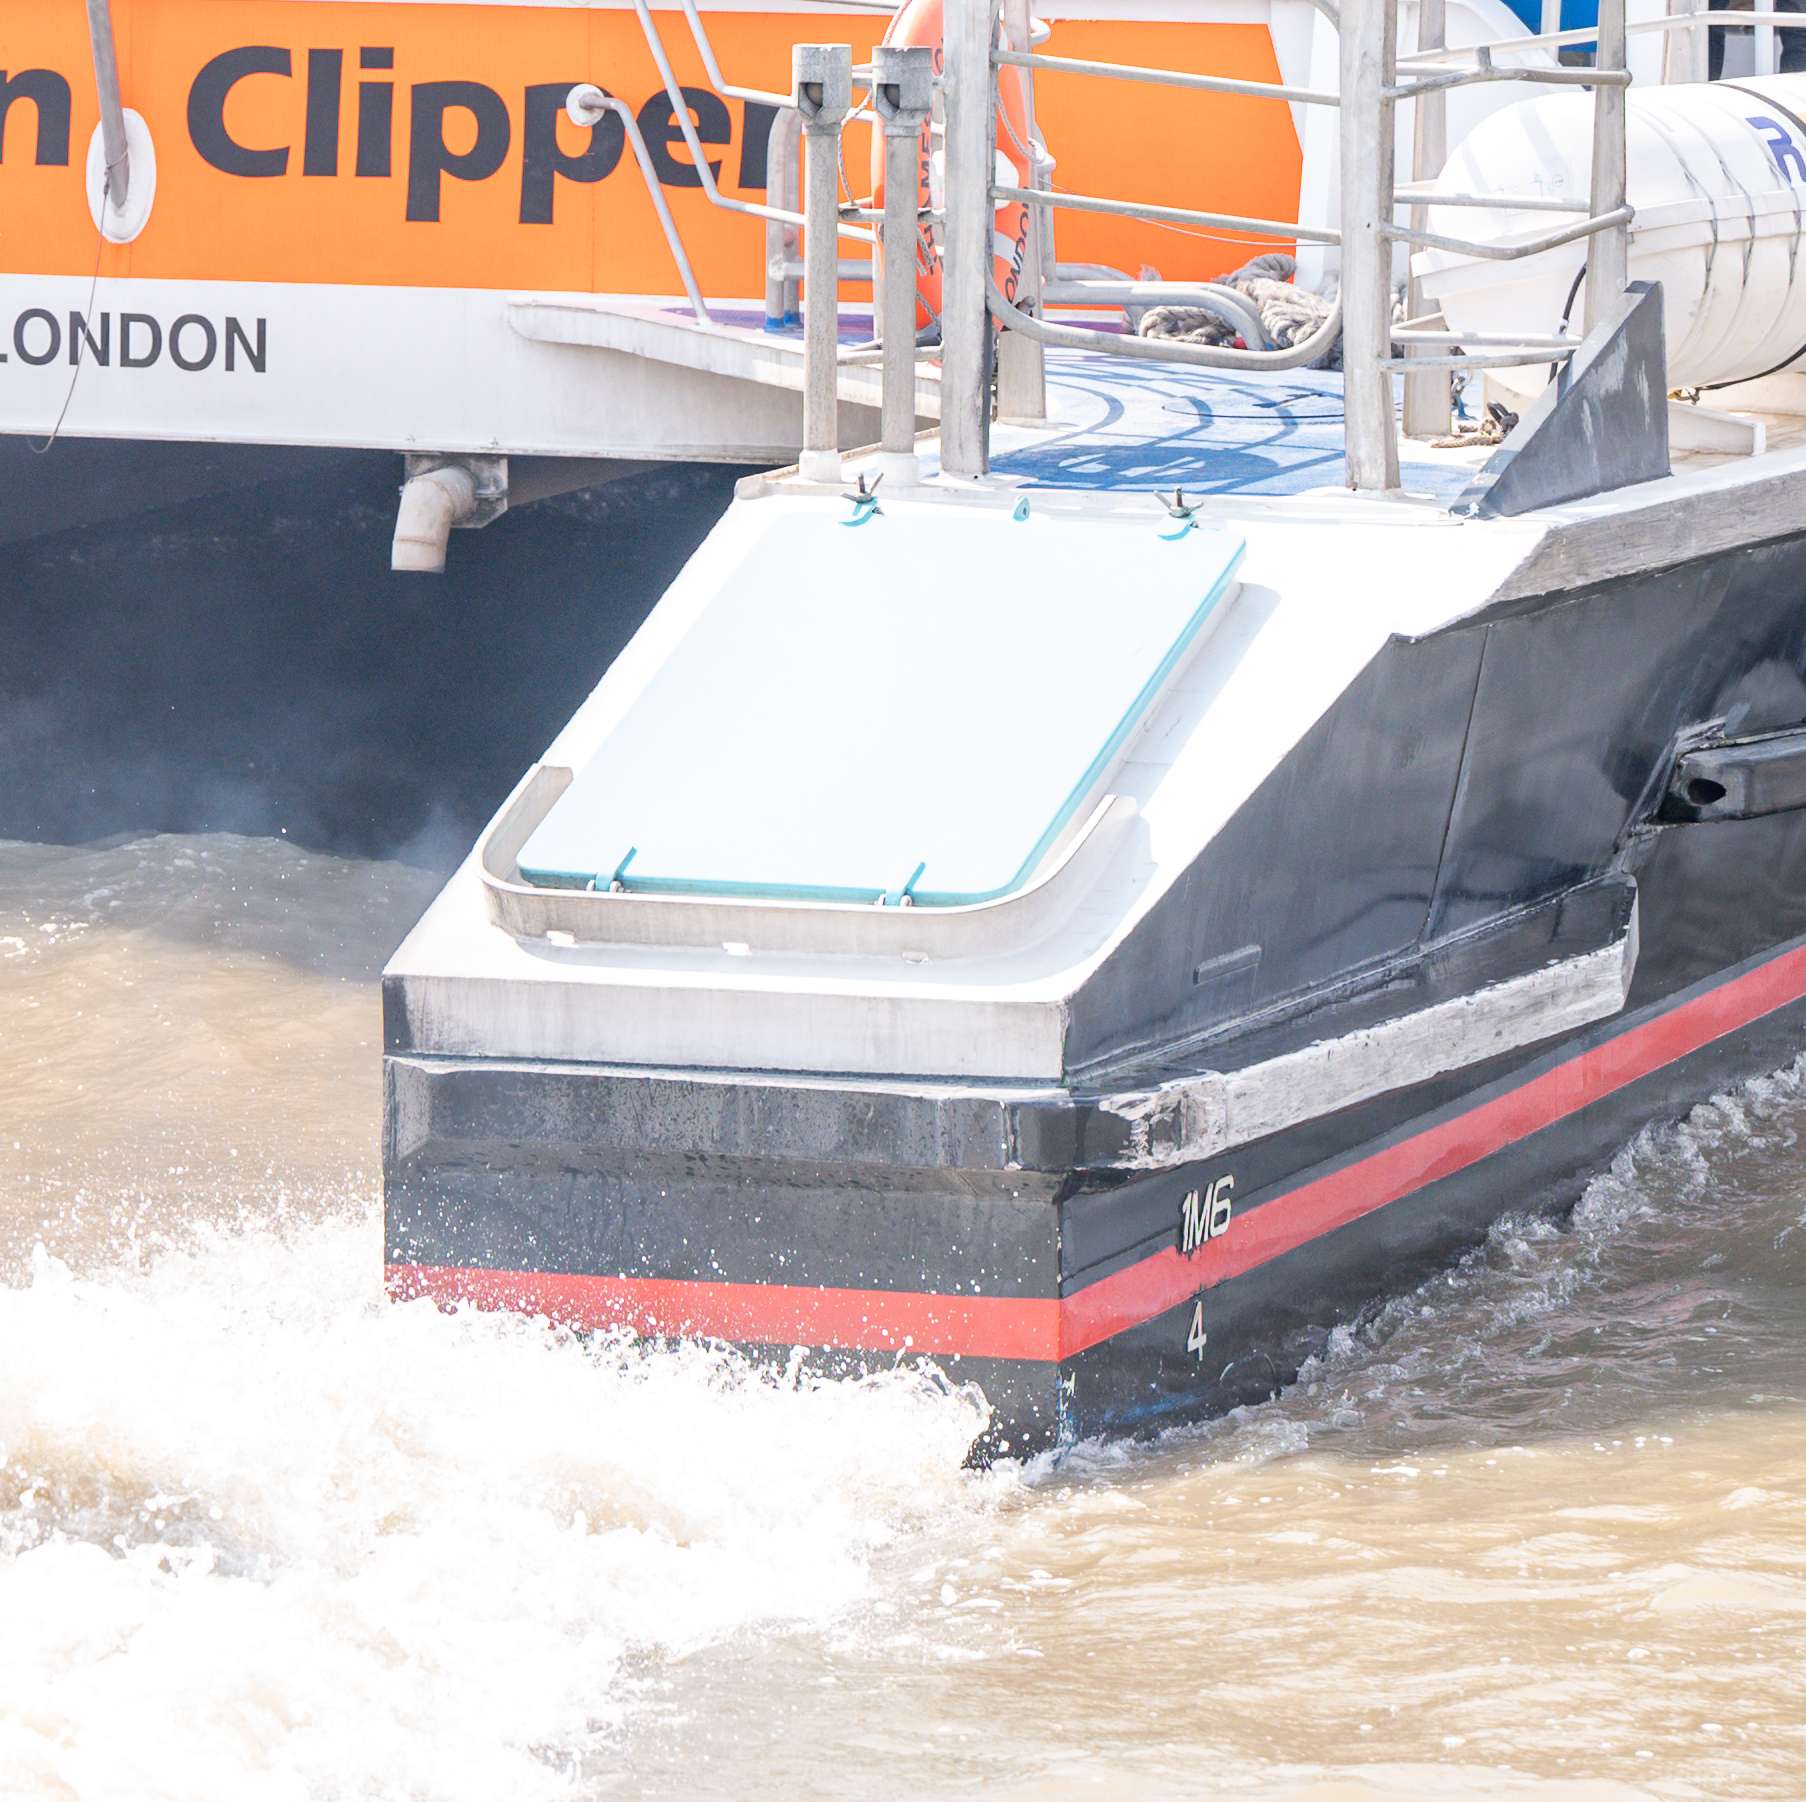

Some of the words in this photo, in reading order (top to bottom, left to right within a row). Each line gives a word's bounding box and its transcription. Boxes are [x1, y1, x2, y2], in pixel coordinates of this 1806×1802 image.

[186, 45, 777, 226] Clipper
[1180, 1173, 1235, 1254] 1M6
[1186, 1300, 1208, 1362] 4
